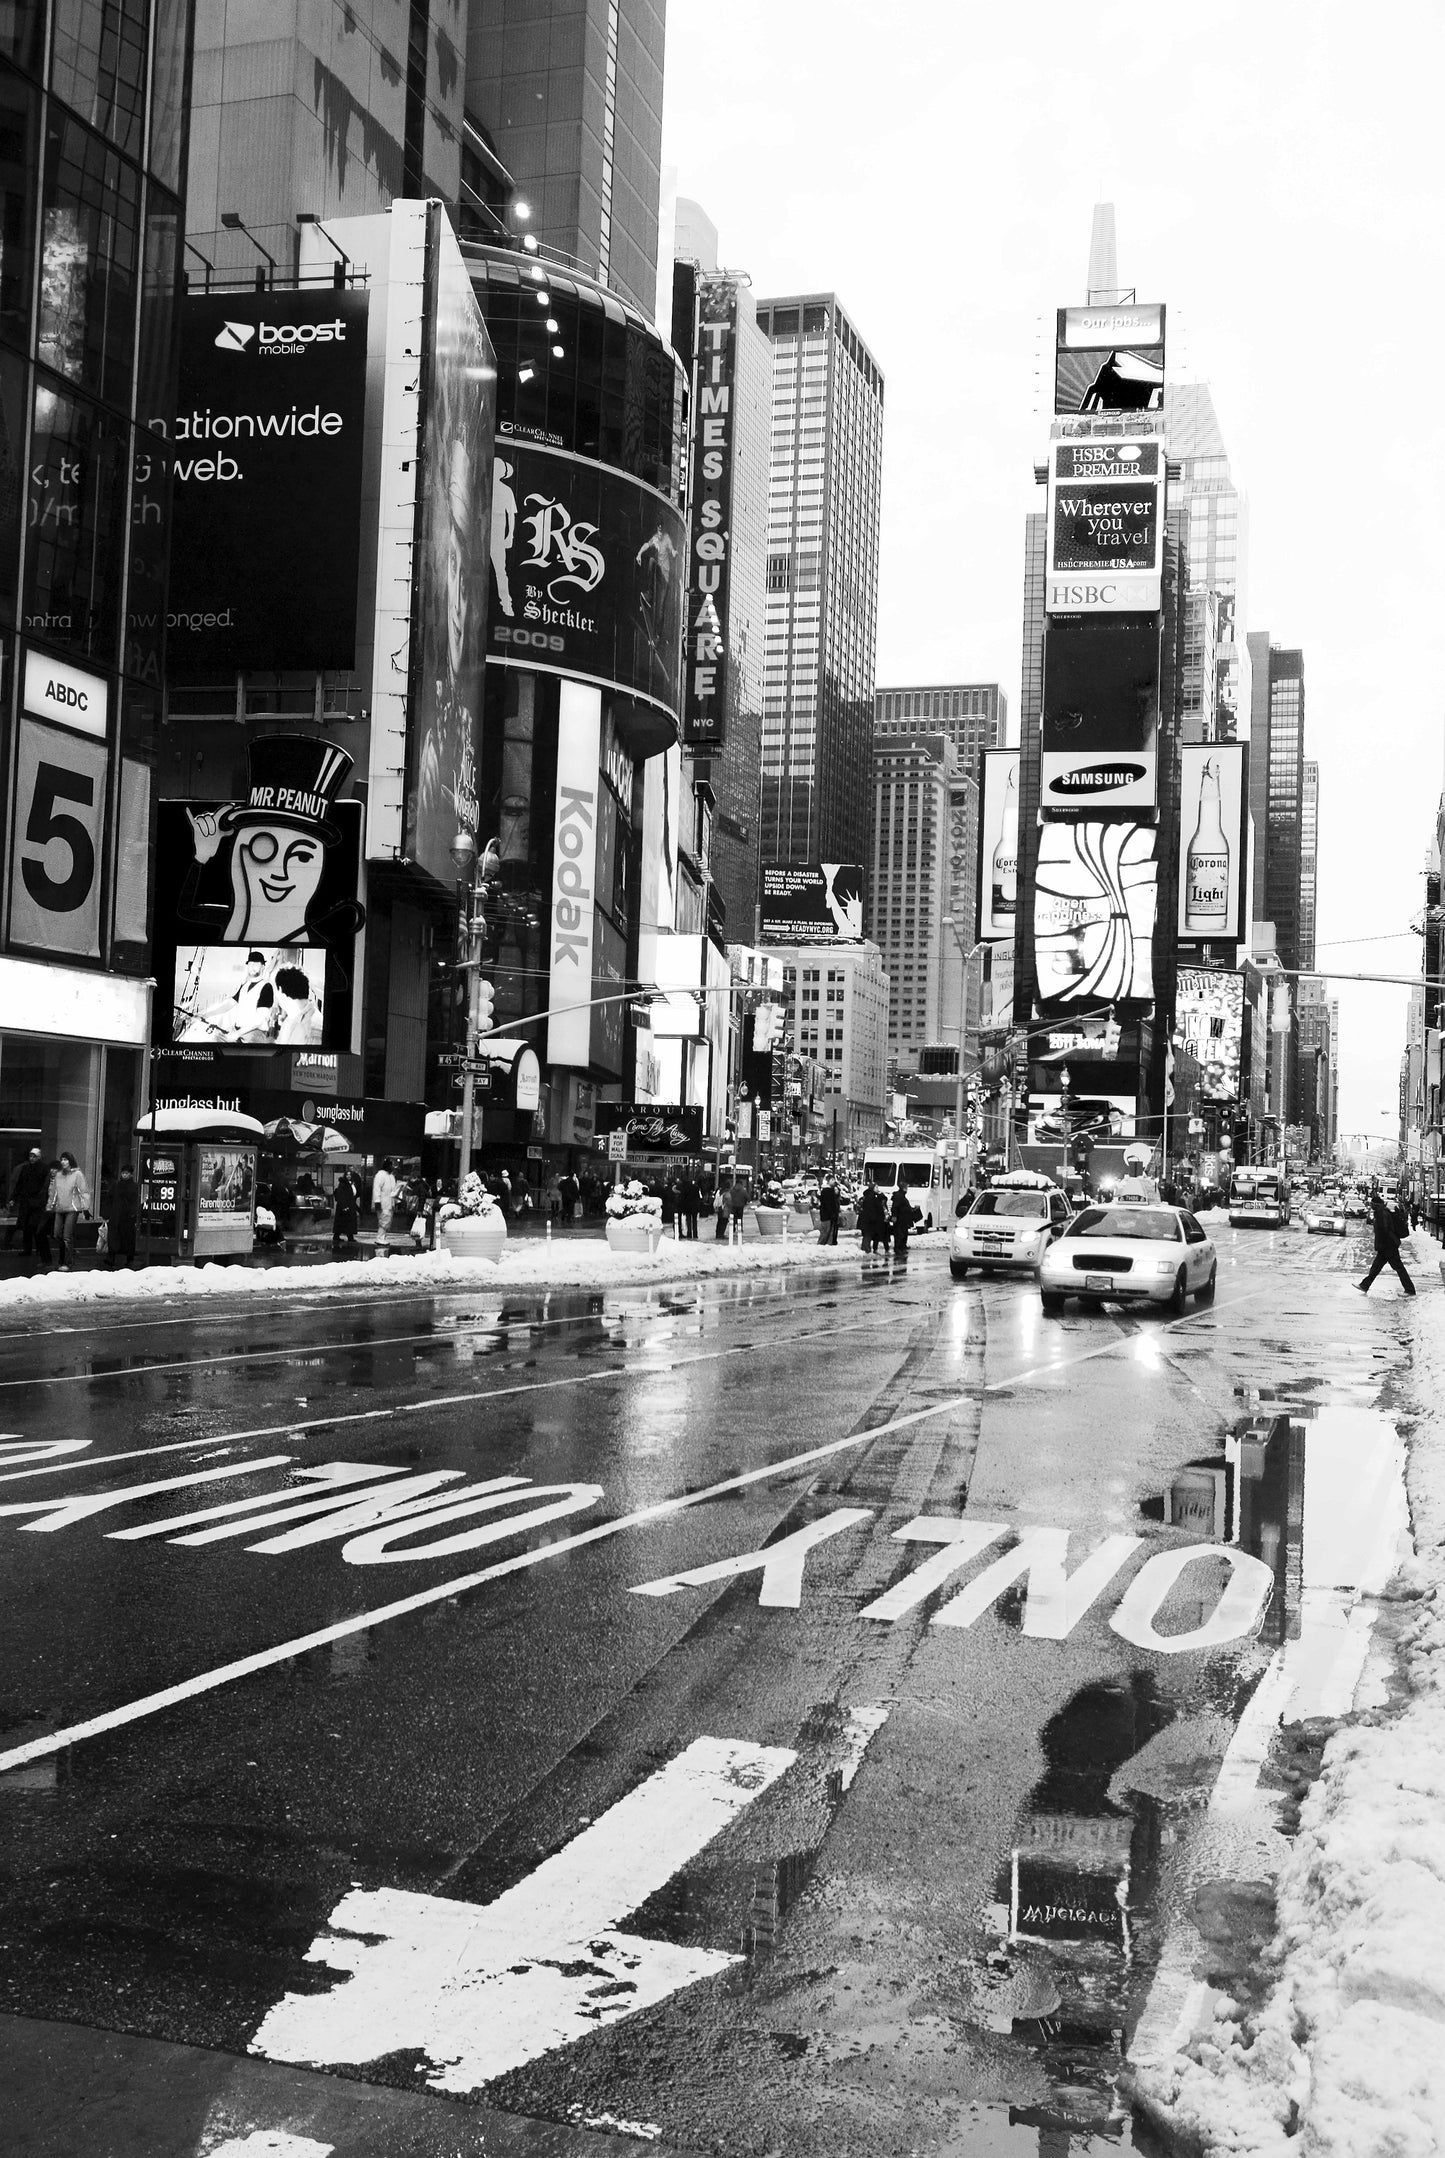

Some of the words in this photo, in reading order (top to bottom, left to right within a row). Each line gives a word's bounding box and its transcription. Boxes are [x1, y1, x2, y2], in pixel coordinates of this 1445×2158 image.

[259, 319, 346, 343] boost
[259, 343, 305, 355] mobile
[701, 322, 731, 480] TIMES
[1072, 447, 1115, 462] HSBC
[1073, 462, 1142, 477] PREMIER
[1060, 499, 1152, 517] Wherever
[1088, 518, 1123, 536] you
[1096, 527, 1149, 546] travel
[525, 584, 543, 600] By
[695, 500, 726, 697] SQUARE
[1052, 585, 1117, 605] HSBC
[523, 600, 595, 633] Sheckler
[494, 626, 565, 652] 2009
[45, 680, 88, 711] ABDC
[692, 718, 714, 728] NYC
[1062, 773, 1134, 785] SAMSUNG
[251, 787, 277, 806] MR.
[279, 789, 329, 819] PEANUT
[21, 760, 94, 912] 5
[996, 857, 1017, 869] Coro
[1190, 857, 1227, 871] Corona
[555, 786, 594, 967] Kodak
[1192, 886, 1223, 902] Light
[1052, 899, 1088, 911] open
[791, 924, 834, 934] READYNYC.ORG
[1076, 1037, 1106, 1049] SONA
[217, 1096, 241, 1112] hut
[615, 1105, 697, 1115] MARQUIS
[317, 1104, 350, 1123] sunglass
[351, 1105, 364, 1122] hut
[626, 1118, 648, 1134] Come
[640, 1117, 664, 1136] Fly
[662, 1124, 690, 1146] Away
[1204, 1154, 1216, 1177] tkts
[161, 1187, 174, 1200] 99
[200, 1198, 235, 1208] Parenthood
[626, 1507, 1275, 1653] ONLY
